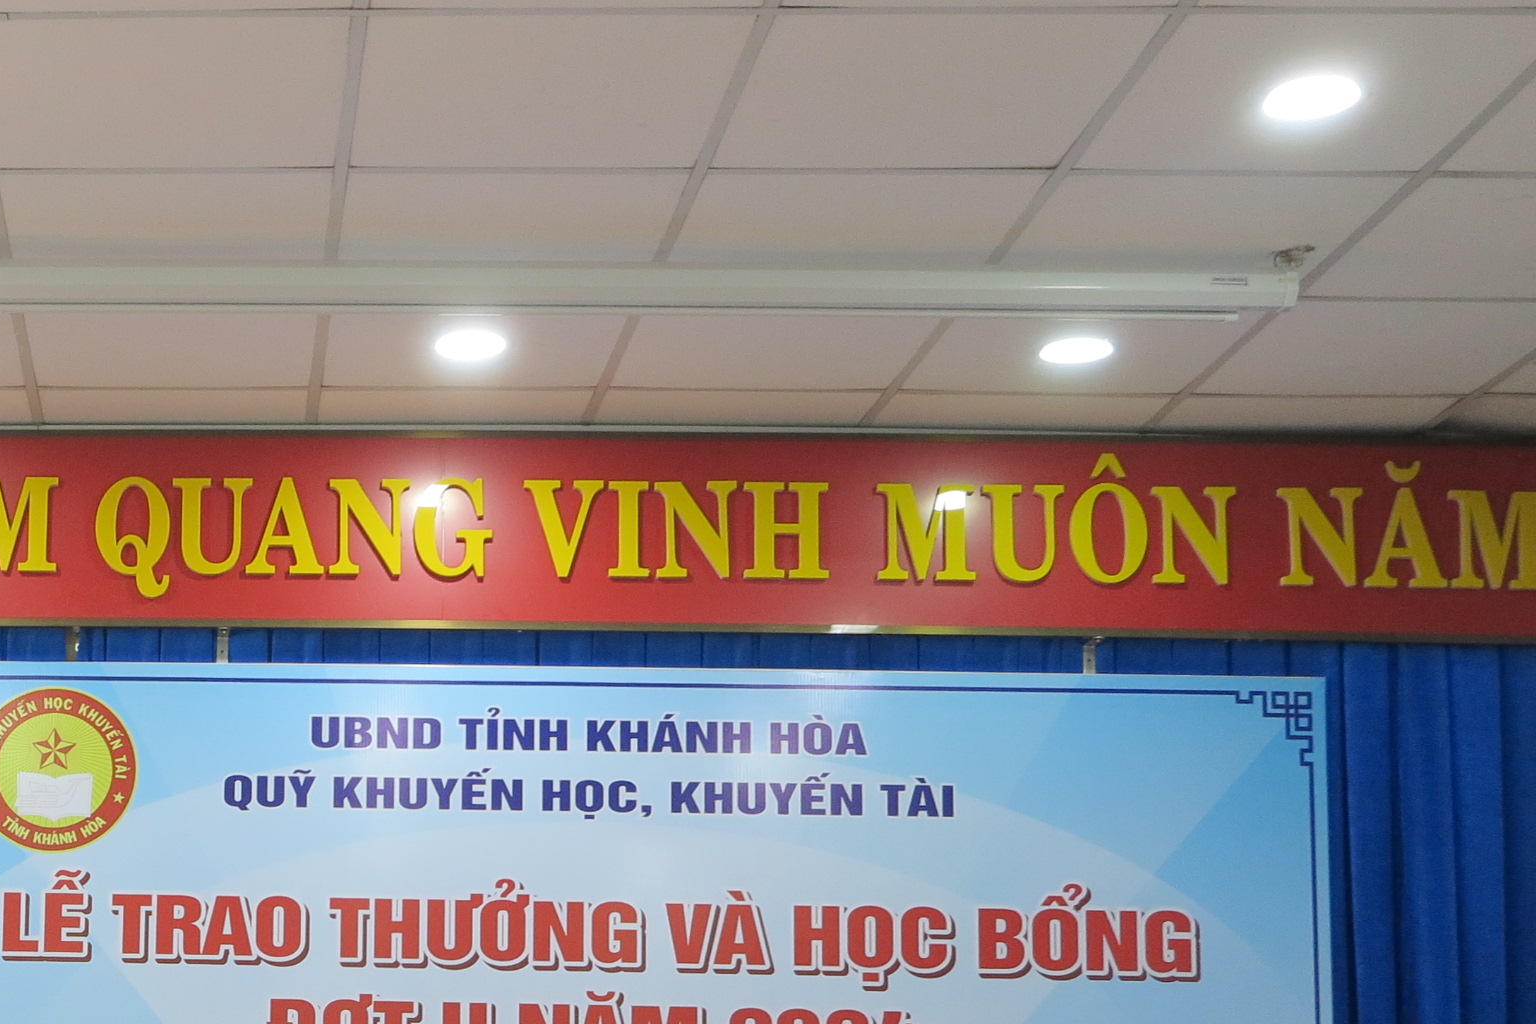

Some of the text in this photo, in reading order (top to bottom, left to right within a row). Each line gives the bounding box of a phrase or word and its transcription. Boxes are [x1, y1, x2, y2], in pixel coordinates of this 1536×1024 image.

[94, 475, 494, 600] QUANG
[523, 478, 831, 582] VINH
[875, 452, 1237, 587] MUÔN
[1275, 459, 1536, 590] NĂM
[43, 697, 74, 712] HỌC
[77, 703, 125, 751] KHUYẾN
[114, 754, 131, 780] TÀI
[310, 706, 868, 756] UBND TỈNH KHÁNH HÒA
[223, 767, 955, 820] QUỸ KHUYẾN HỌC, KHUYẾN TÀI
[1, 815, 107, 845] TỈNH KHÁNH HÒA
[1, 868, 1201, 991] LỄ TRAO THƯỞNG VÀ HỌC BỔNG
